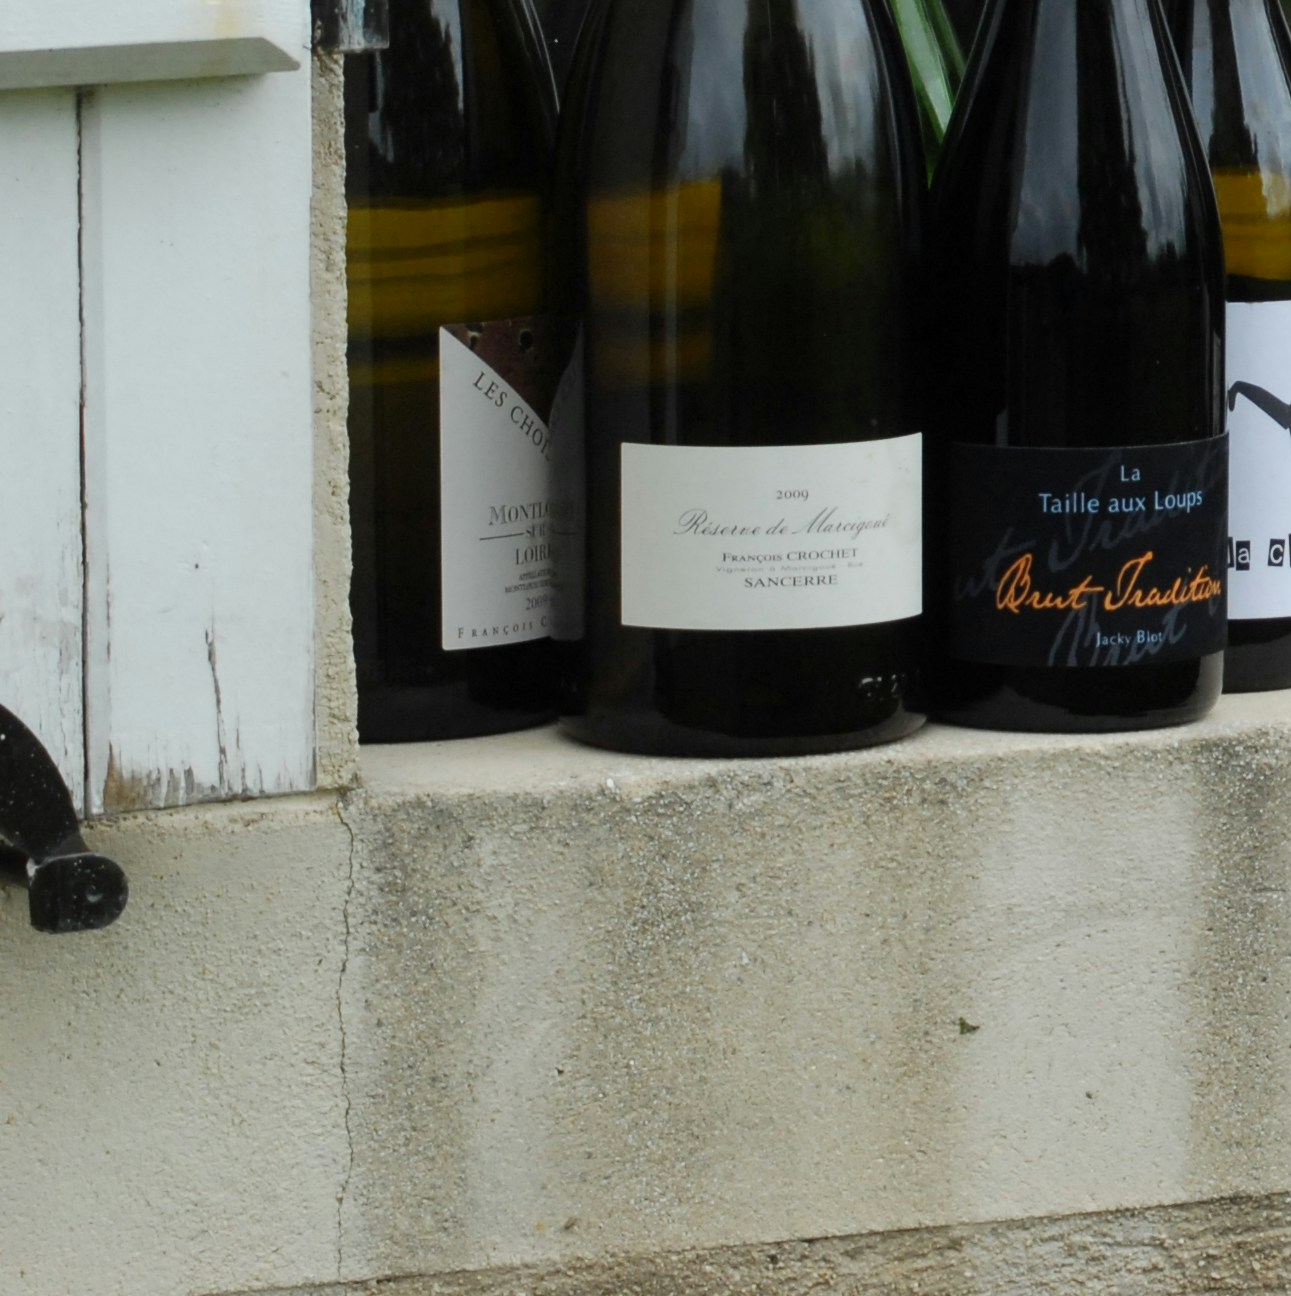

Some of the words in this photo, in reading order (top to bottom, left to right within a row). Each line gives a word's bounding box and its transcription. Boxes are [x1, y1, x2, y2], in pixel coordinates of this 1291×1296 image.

[473, 371, 508, 408] LES
[1120, 465, 1141, 482] La
[776, 489, 809, 501] 2009
[1038, 493, 1100, 513] Taille
[1107, 496, 1147, 513] aux
[1154, 489, 1204, 513] Loups
[673, 507, 761, 536] Réserve
[766, 517, 792, 536] de
[722, 552, 783, 564] FRANÇOIS
[786, 547, 860, 561] CROCHET
[744, 574, 839, 589] SANCERRE
[995, 553, 1104, 613] Brut
[1104, 550, 1222, 612] Tradition
[458, 620, 532, 639] FRANÇOIS
[1095, 631, 1132, 648] Jacky
[1136, 629, 1164, 644] Blot
